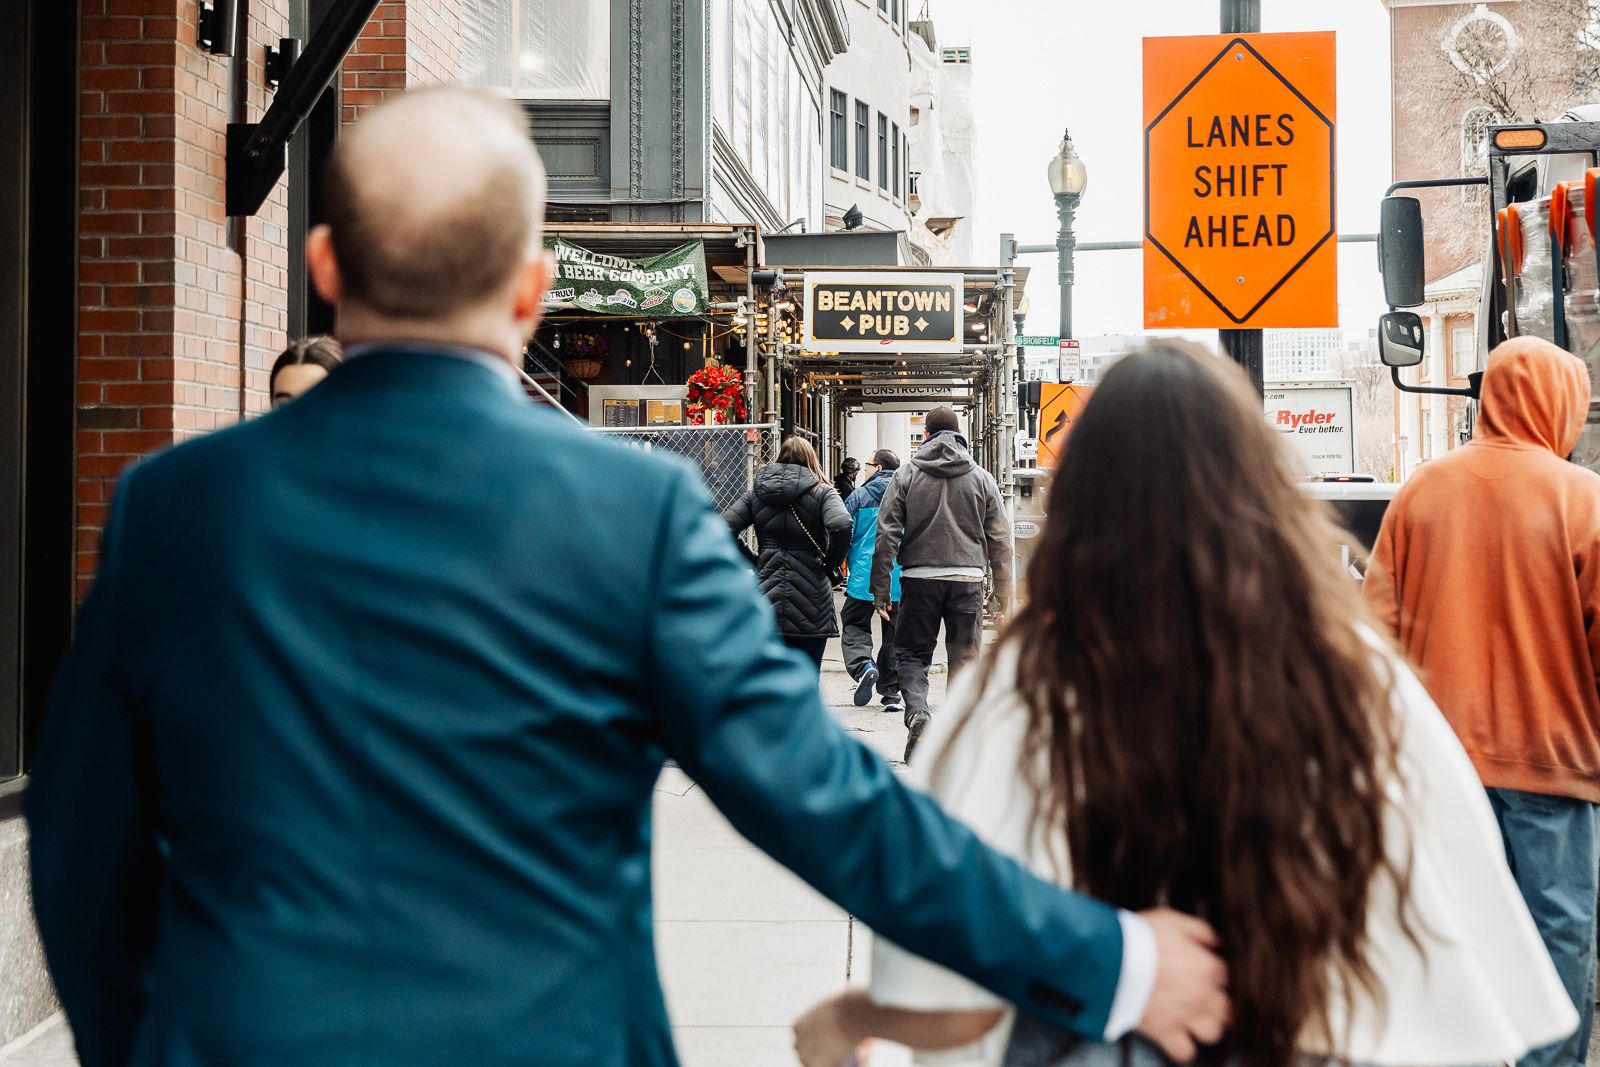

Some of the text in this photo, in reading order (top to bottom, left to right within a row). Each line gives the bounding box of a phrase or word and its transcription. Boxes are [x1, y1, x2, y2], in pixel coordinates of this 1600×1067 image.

[1187, 113, 1294, 148] LANES
[1193, 164, 1288, 197] SHIFT
[1184, 214, 1295, 248] AHEAD
[563, 264, 605, 281] BEER
[608, 263, 695, 284] COMPANY!
[550, 289, 573, 299] TRULY
[818, 290, 950, 312] BEANTOWN
[859, 314, 910, 336] PUB
[1023, 337, 1055, 345] BROMFIELD
[863, 386, 952, 395] CONSTRUCTION
[1276, 410, 1336, 428] Ryder
[1318, 425, 1344, 433] better.
